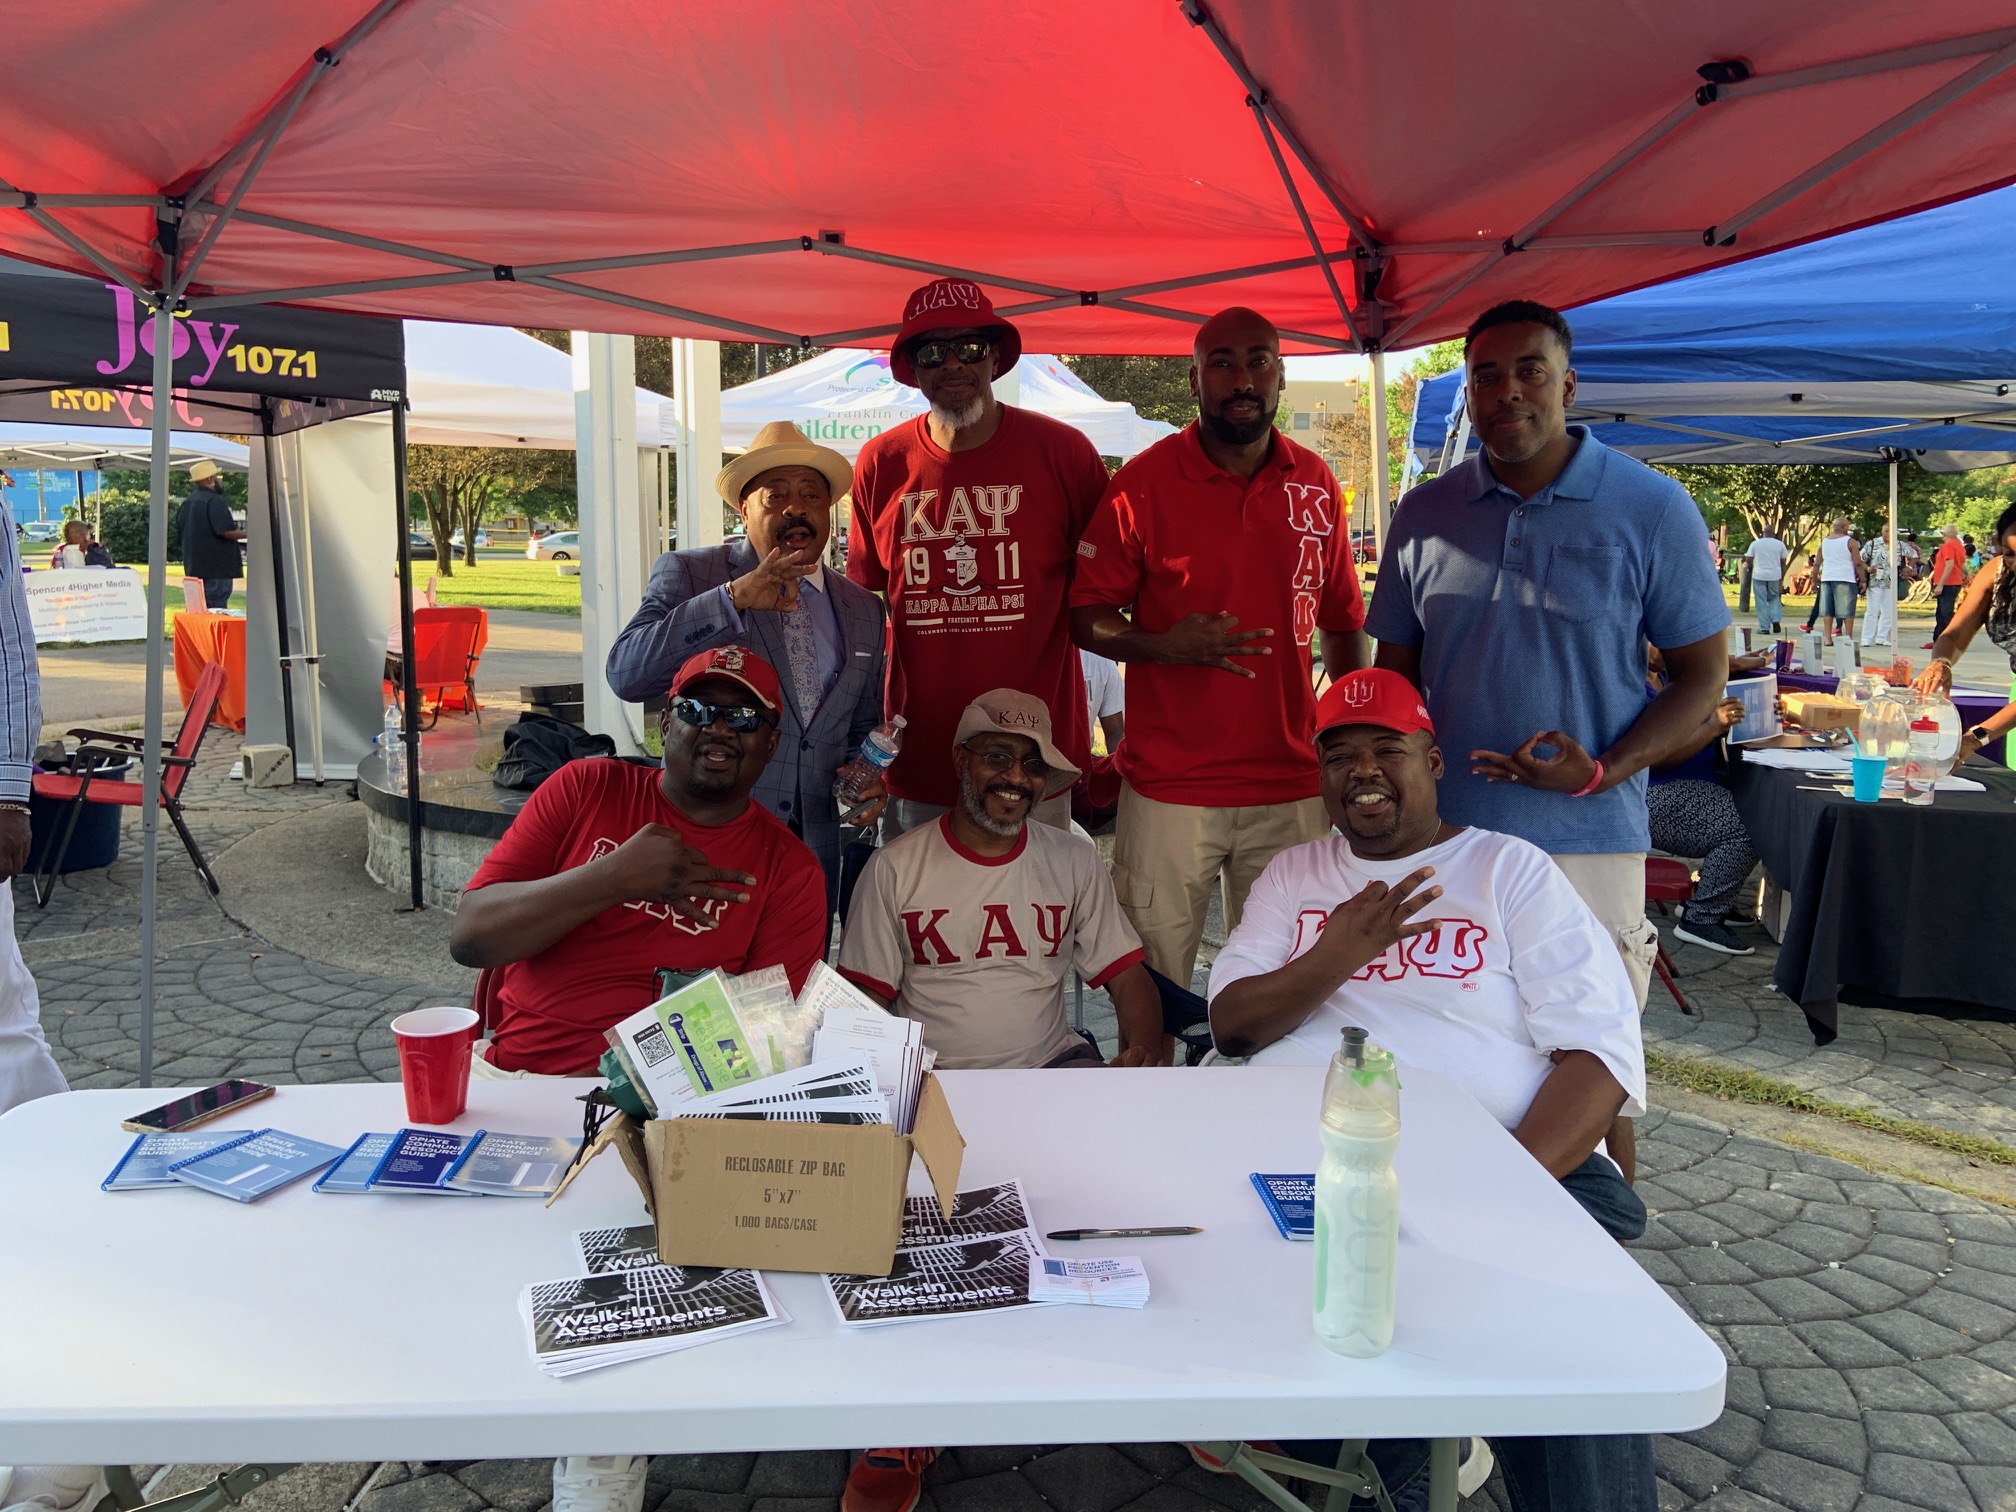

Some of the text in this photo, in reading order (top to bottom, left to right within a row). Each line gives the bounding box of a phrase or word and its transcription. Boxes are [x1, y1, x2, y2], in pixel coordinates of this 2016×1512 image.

[97, 284, 317, 386] Joy 107.1
[902, 541, 1020, 586] 19 11
[26, 580, 131, 596] Spencer 4Higher Media
[906, 594, 1024, 614] KAPPA ALPHA PSI
[677, 1028, 686, 1039] Strip
[690, 1053, 699, 1066] Drugs
[253, 1139, 309, 1158] COMMUNITY
[409, 1136, 450, 1145] OPIATE
[484, 1142, 552, 1152] COMMUNITY
[487, 1138, 527, 1146] OPIATE
[236, 1146, 266, 1158] GUIDE
[400, 1150, 436, 1158] GUIDE
[480, 1146, 542, 1156] RESOURCE
[724, 1156, 846, 1177] RECLOSABLE ZIP BAG
[765, 1216, 818, 1231] BAGS/CASE
[852, 1281, 947, 1300] Walk-In
[858, 1284, 1015, 1310] Assessments
[860, 1306, 897, 1315] Columbus
[952, 1299, 979, 1307] Alcohol
[985, 1296, 1004, 1304] Drug
[552, 1304, 655, 1328] Walk-In
[554, 1305, 727, 1339] Assessments
[555, 1336, 596, 1345] Columbus
[598, 1332, 621, 1340] Public
[656, 1323, 686, 1331] Alcohol
[694, 1318, 713, 1326] Drug
[714, 1311, 747, 1322] Services
